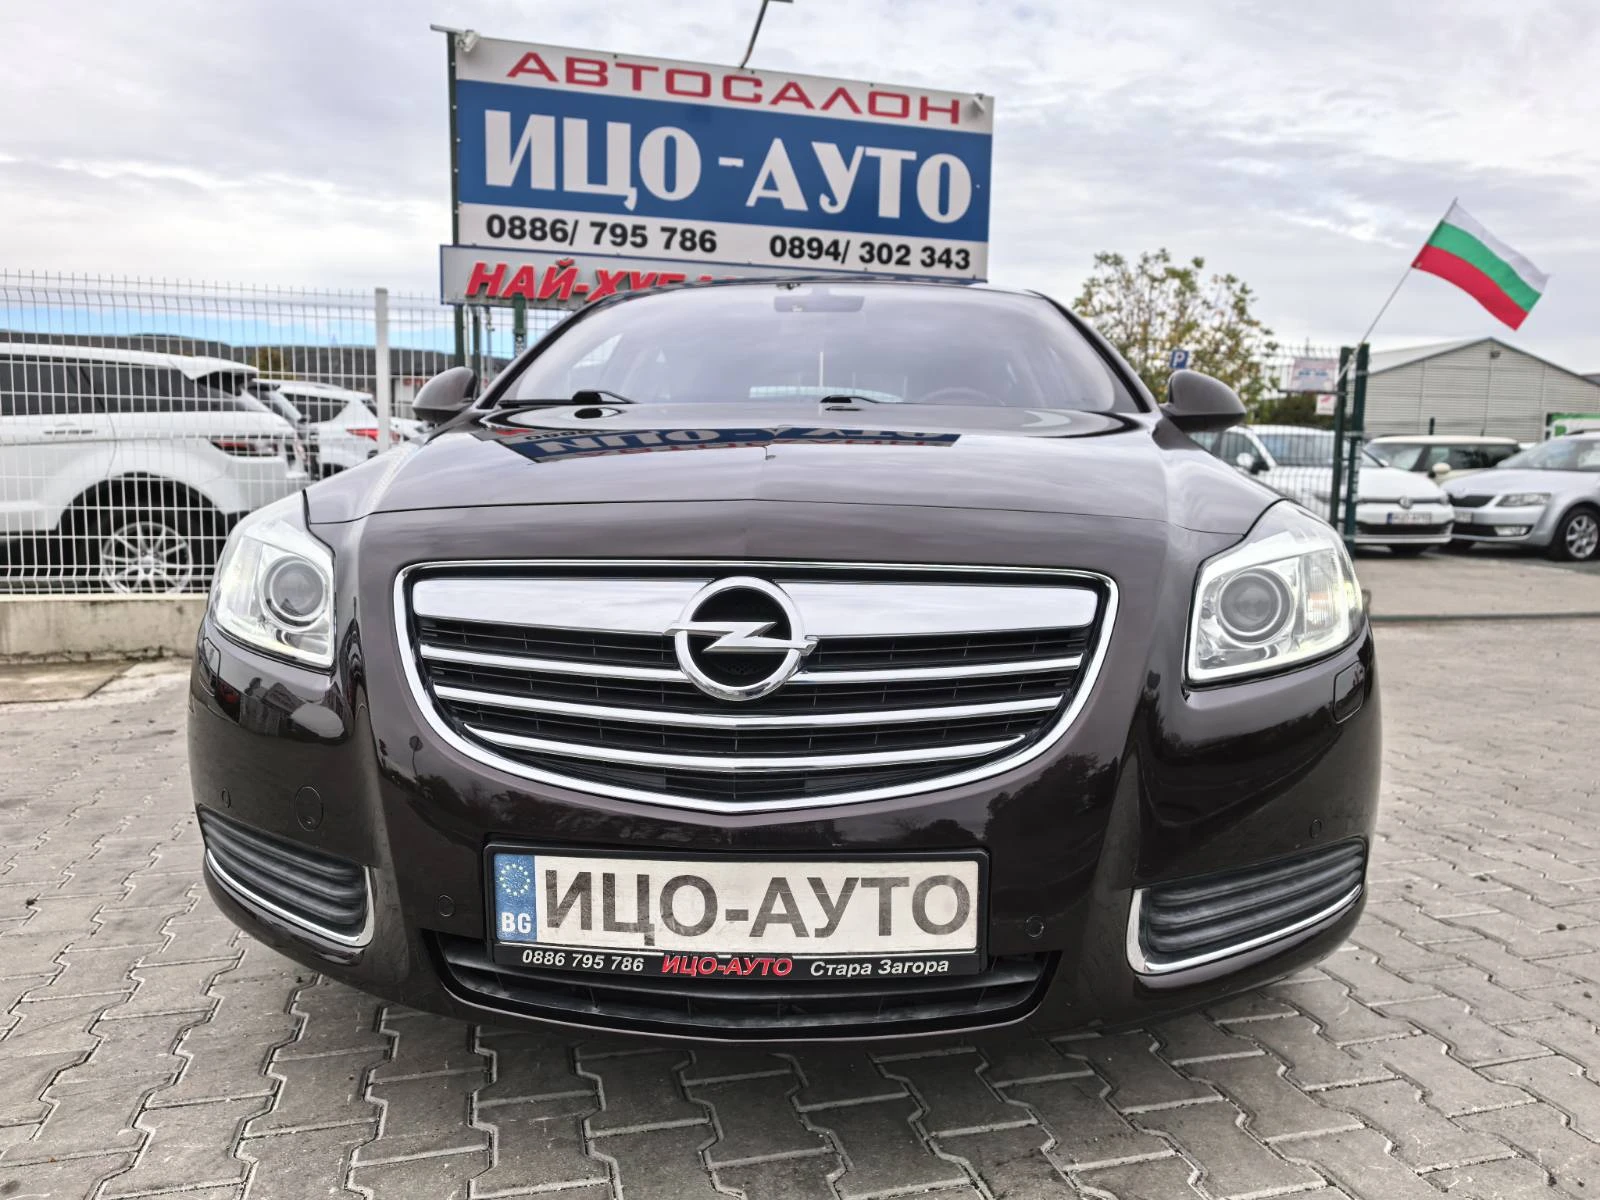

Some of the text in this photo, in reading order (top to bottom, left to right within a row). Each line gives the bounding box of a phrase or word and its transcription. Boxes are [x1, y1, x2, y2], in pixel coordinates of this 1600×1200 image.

[506, 51, 961, 124] АВТОСАЛОН
[486, 213, 718, 253] 0886/ 795 786
[769, 234, 971, 270] 0894/ 302 343
[501, 912, 533, 934] BG
[545, 869, 972, 947] ИЦО-АУТО
[522, 949, 950, 978] 0886 795 786 ИЦО-АУТО Стара Загора
